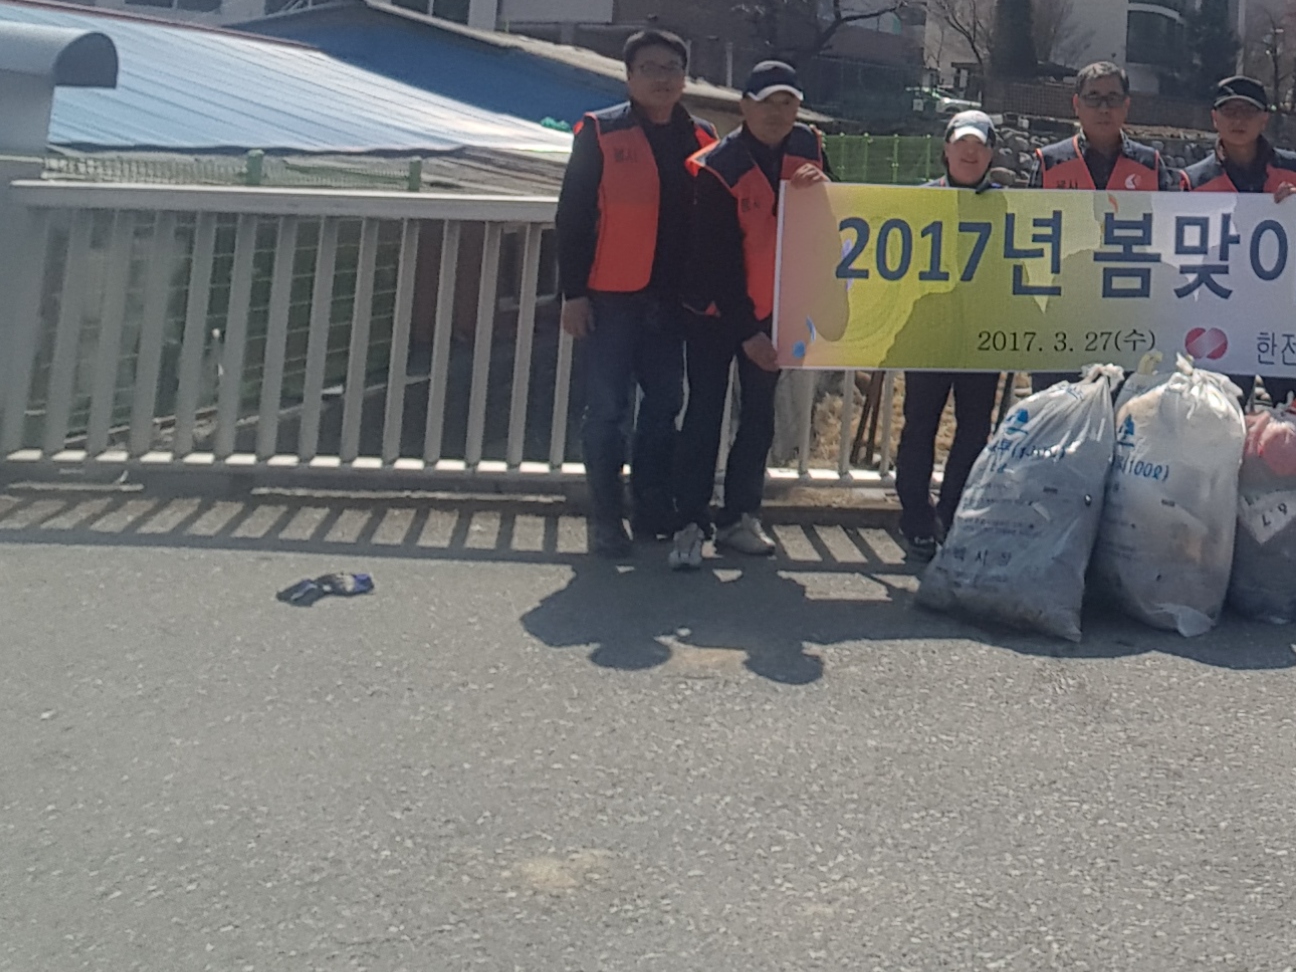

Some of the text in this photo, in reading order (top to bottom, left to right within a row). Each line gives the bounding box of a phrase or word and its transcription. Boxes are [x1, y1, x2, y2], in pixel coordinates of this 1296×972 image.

[835, 211, 1062, 296] 2017년
[976, 328, 1156, 353] 2017. 3. 27(수)
